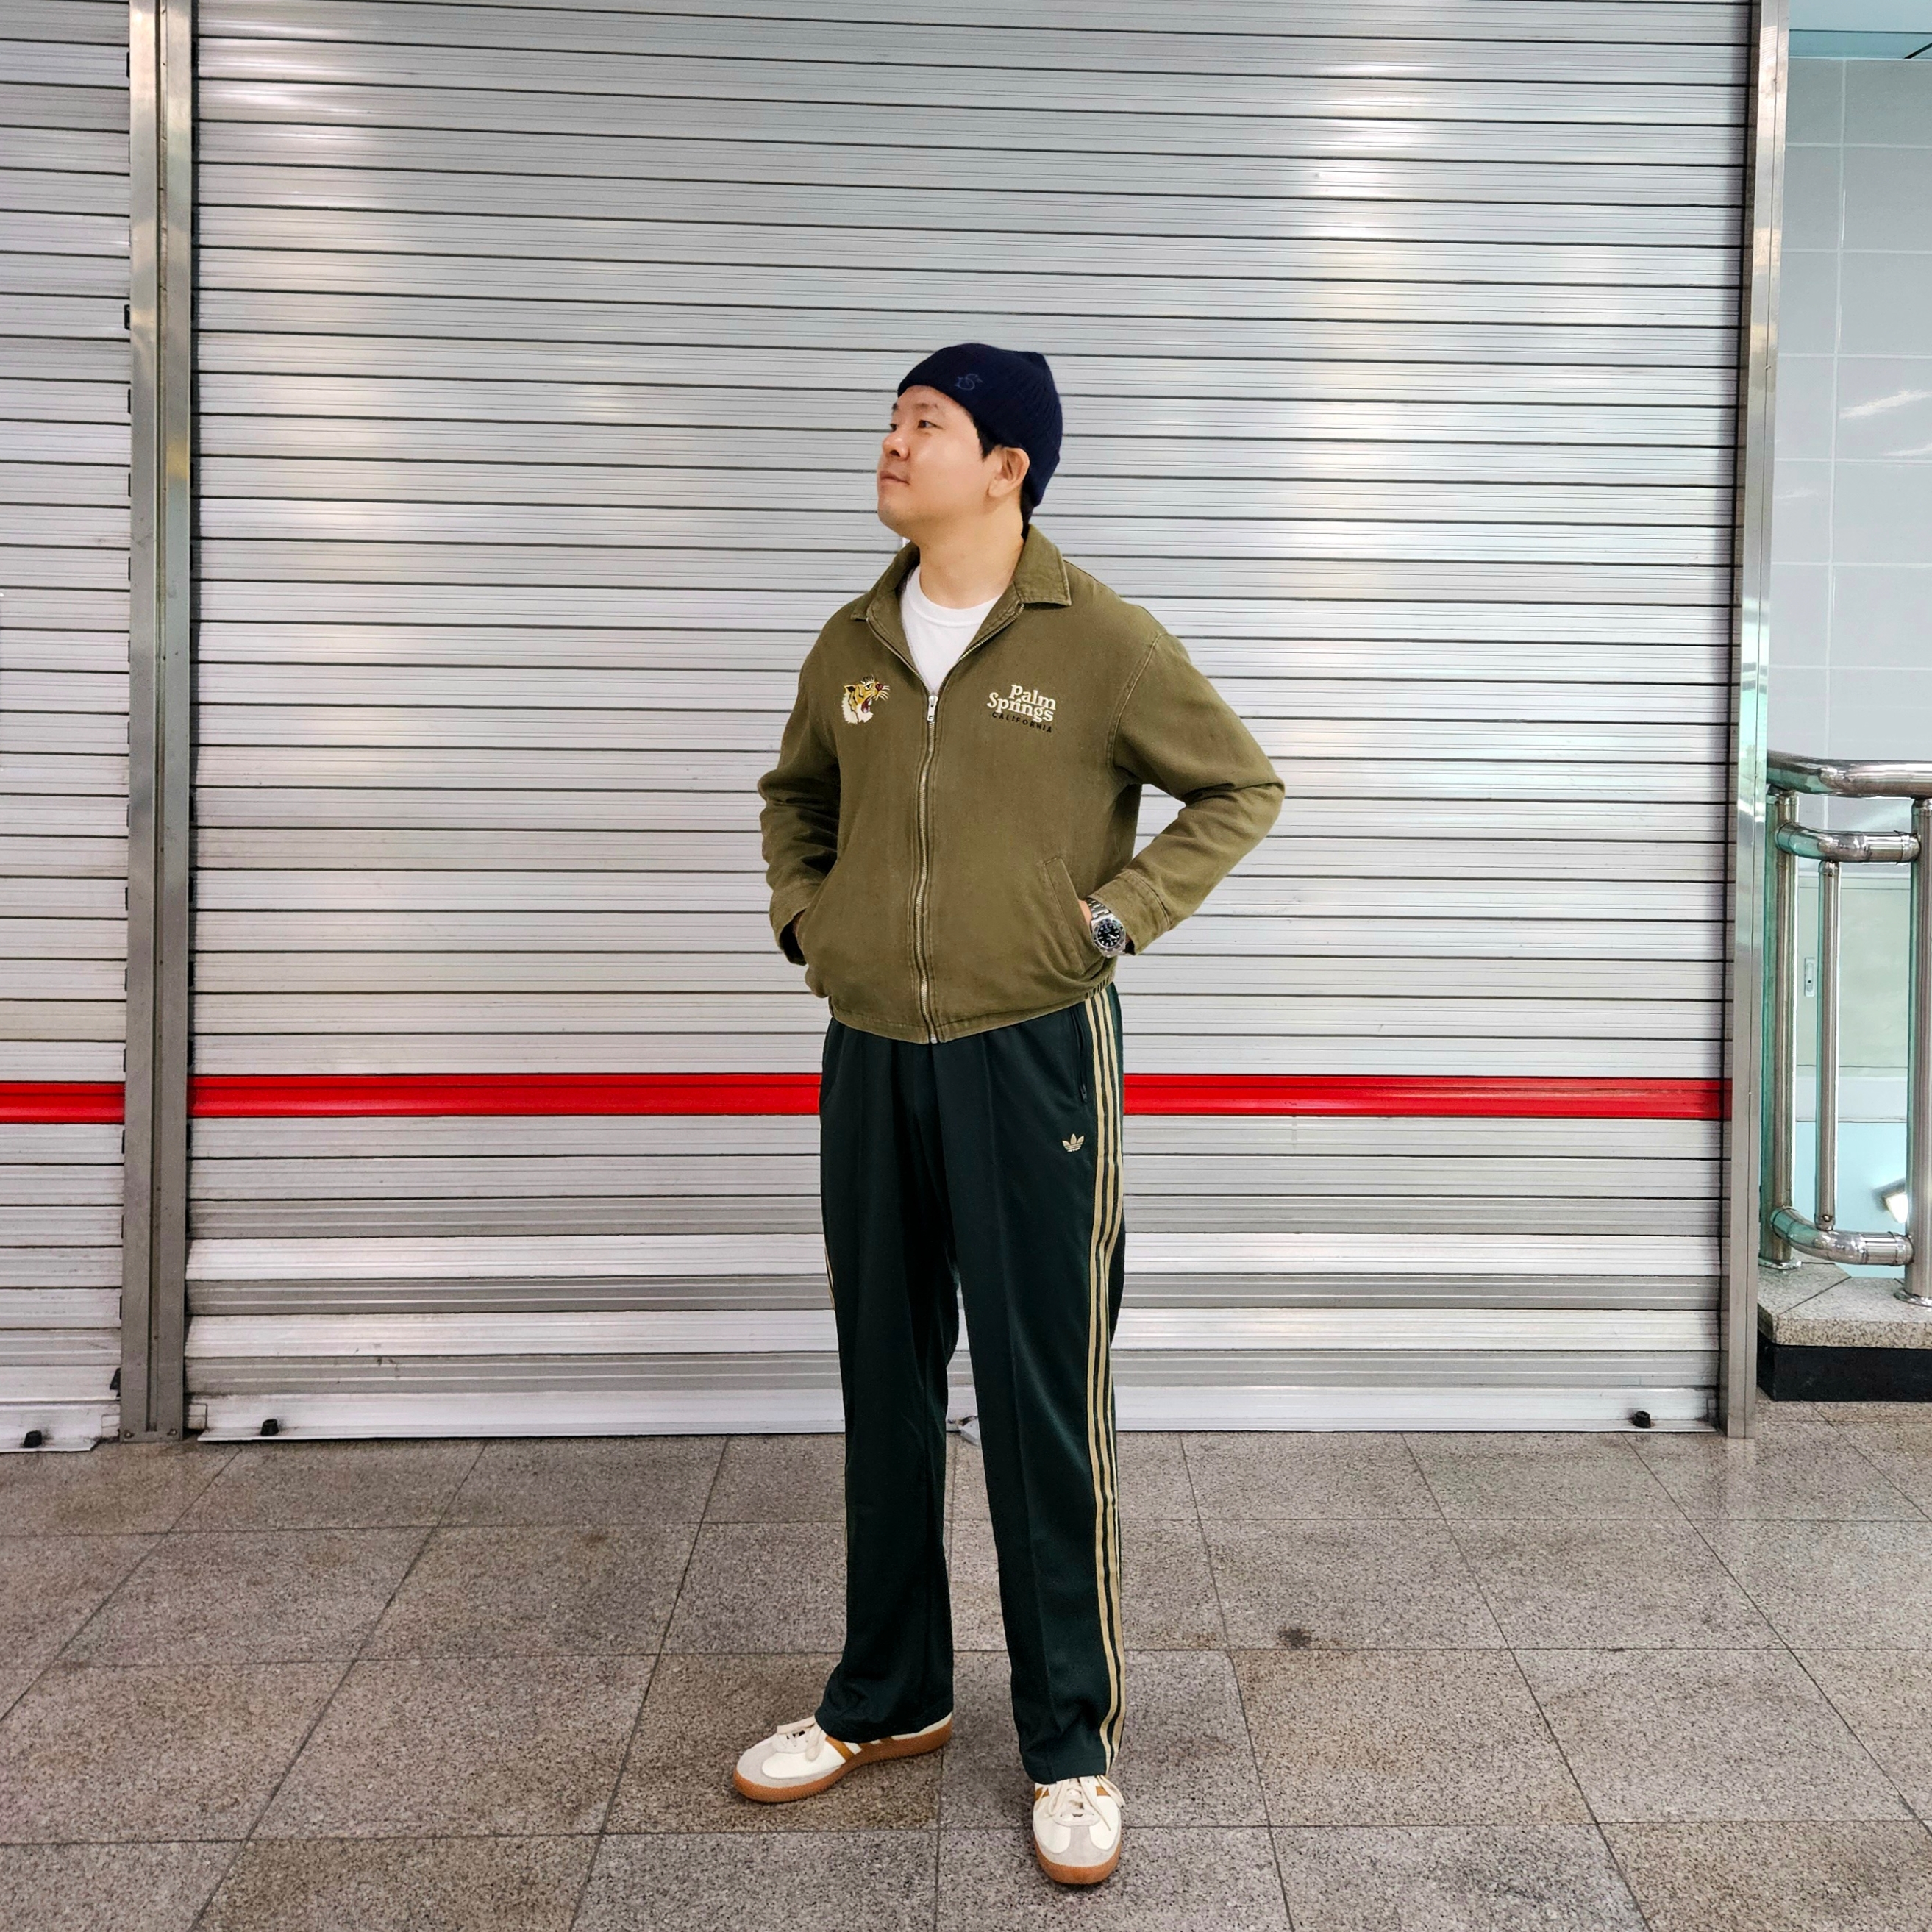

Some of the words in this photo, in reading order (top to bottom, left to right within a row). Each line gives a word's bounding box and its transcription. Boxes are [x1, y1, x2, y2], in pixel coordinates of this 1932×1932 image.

[986, 692, 1054, 723] Springs
[1008, 684, 1056, 710] Palm
[992, 711, 1052, 733] CALIFORNIA
